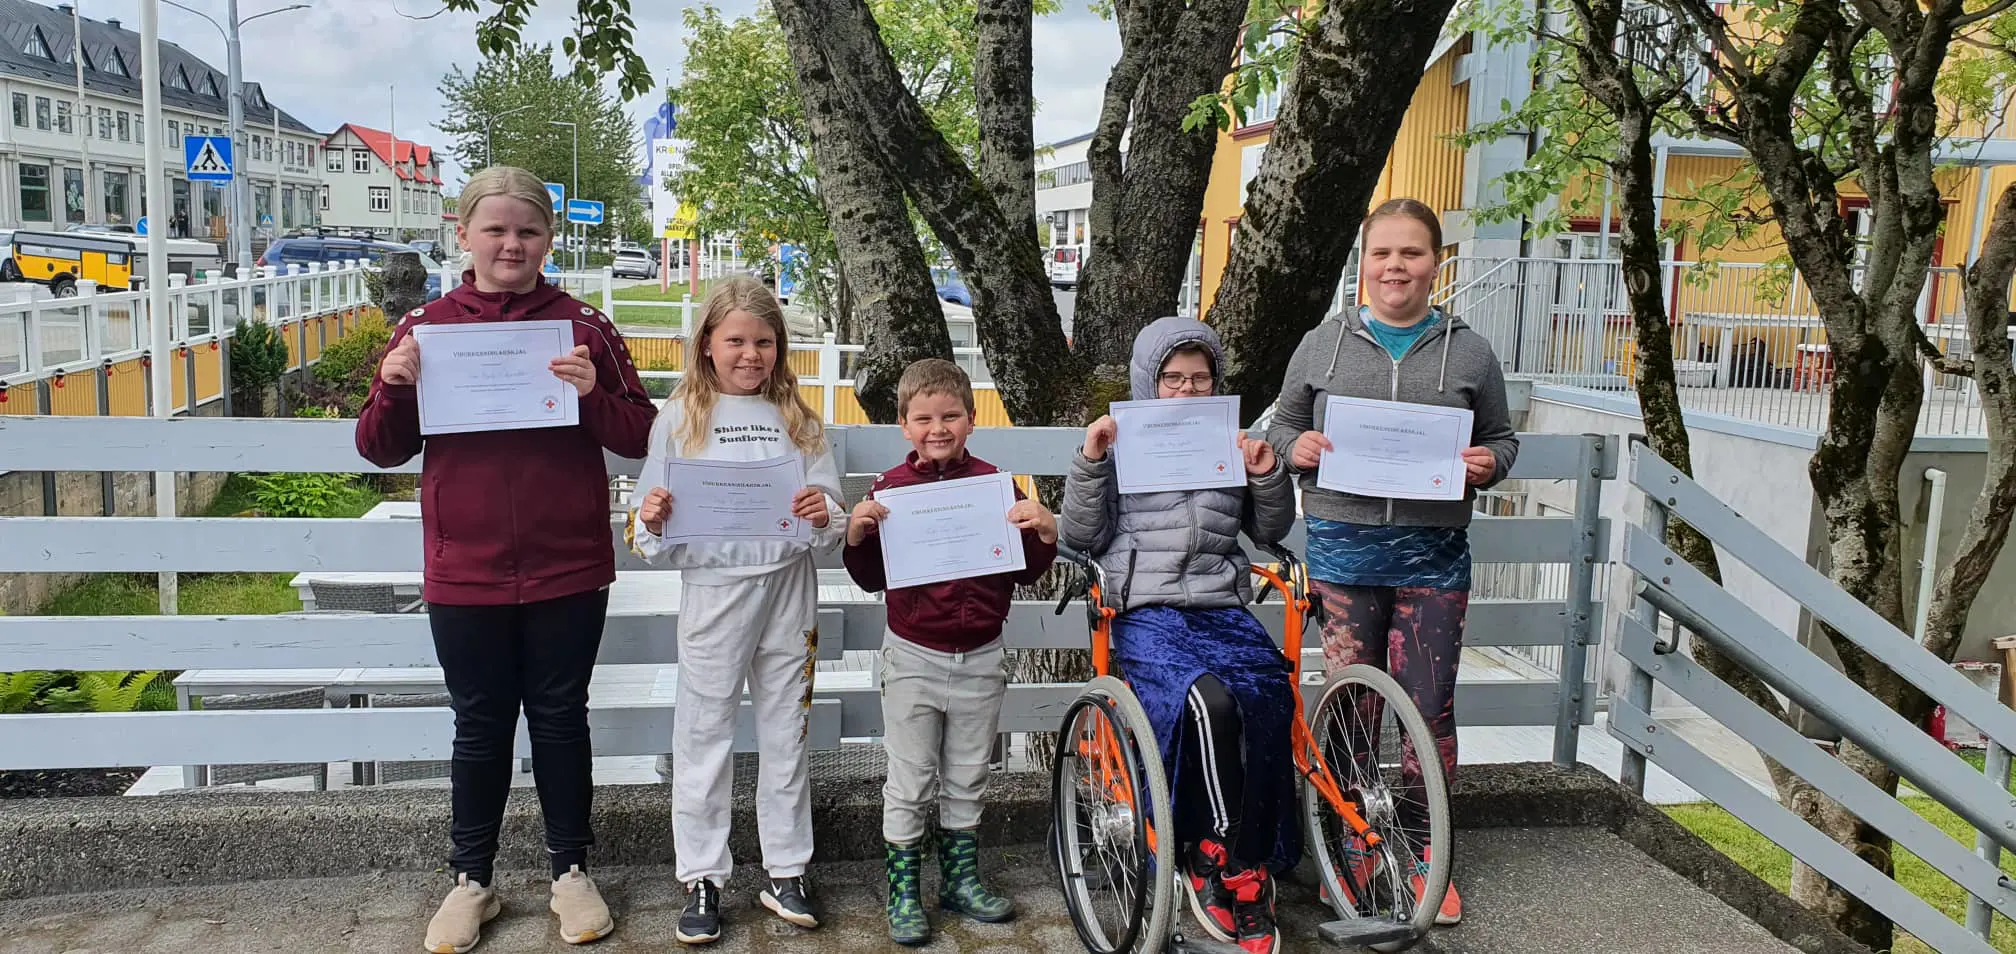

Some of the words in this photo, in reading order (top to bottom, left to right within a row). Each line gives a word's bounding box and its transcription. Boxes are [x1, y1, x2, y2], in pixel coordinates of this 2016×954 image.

[714, 425, 748, 434] Shine
[750, 425, 772, 433] like
[719, 434, 779, 444] Sunflower
